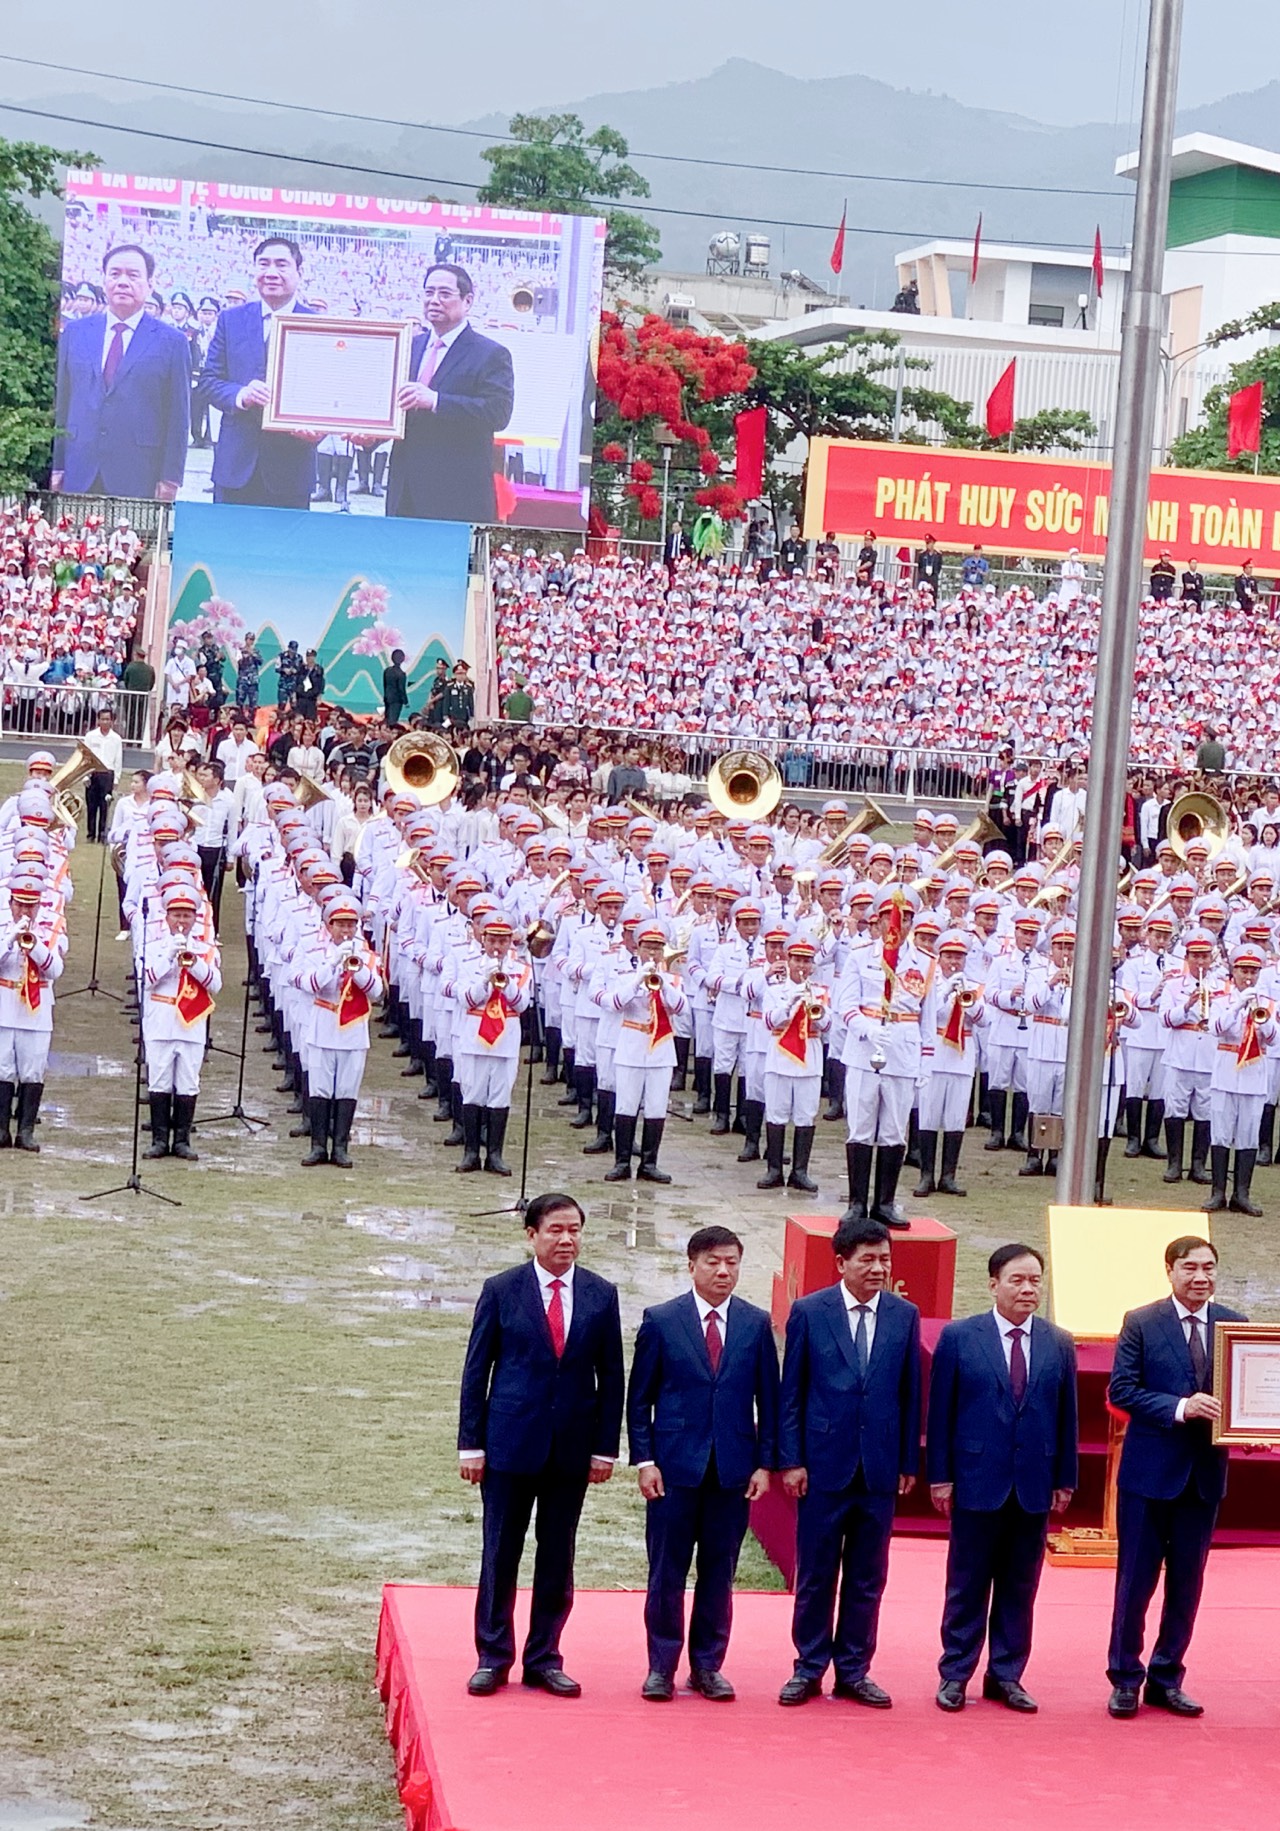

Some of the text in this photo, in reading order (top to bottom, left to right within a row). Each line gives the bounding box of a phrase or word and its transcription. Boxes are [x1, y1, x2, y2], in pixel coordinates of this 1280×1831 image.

[875, 472, 951, 523] PHÁT
[959, 484, 1017, 529] HUY
[1025, 483, 1083, 535] SỨC
[1092, 496, 1179, 542] MNH
[1190, 498, 1263, 549] TOÀN
